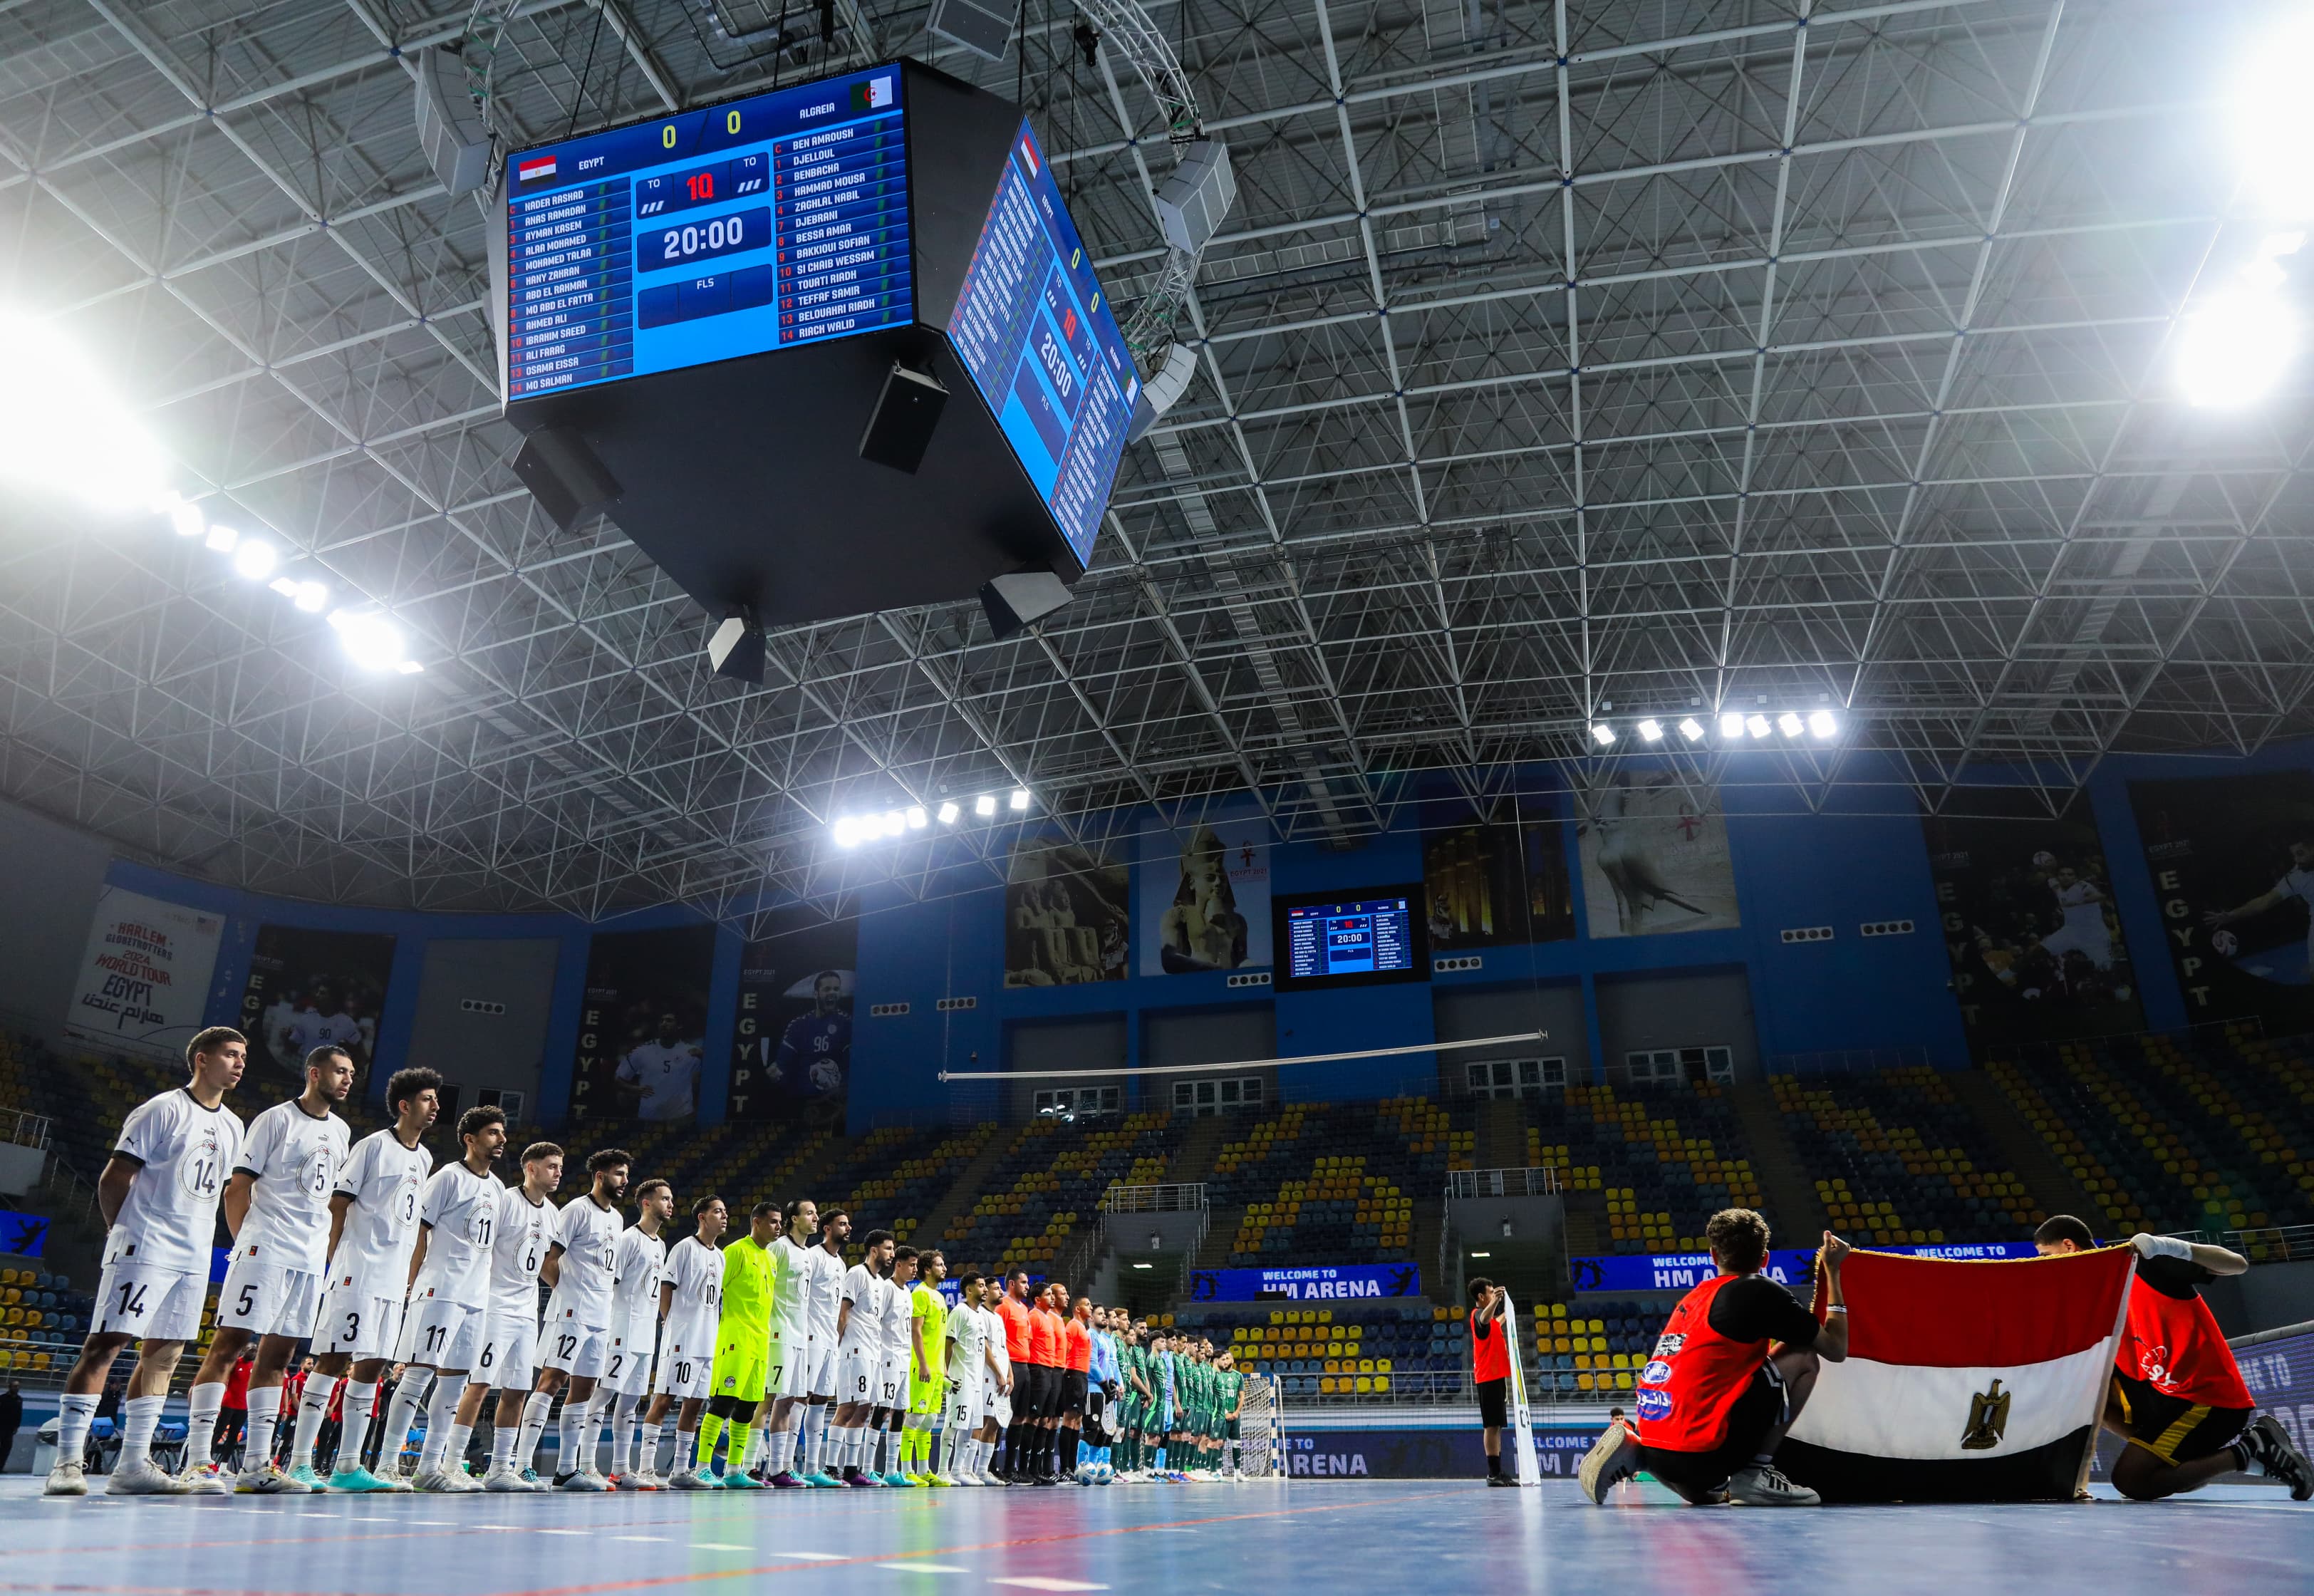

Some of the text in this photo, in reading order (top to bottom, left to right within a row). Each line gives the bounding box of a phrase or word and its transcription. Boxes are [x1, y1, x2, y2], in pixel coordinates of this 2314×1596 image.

[799, 102, 835, 119] ALGREIA
[727, 110, 741, 135] 0
[663, 125, 676, 149] 0
[793, 138, 809, 150] BEN
[812, 128, 853, 145] AMROUSH
[578, 156, 604, 170] EGYPT
[743, 157, 757, 167] TO
[794, 149, 834, 165] DJELLOUL
[648, 179, 660, 189] TO
[777, 163, 839, 184] 2 BENBACHA
[777, 173, 865, 200] 3 HAMMAD MOUSA
[525, 198, 550, 211] NADER
[552, 190, 583, 205] RASHAD
[795, 196, 832, 212] ZAGHLAL
[835, 190, 859, 203] NABIL
[525, 214, 546, 226] ANAS
[548, 204, 586, 221] RAMADAN
[779, 210, 837, 230] 7 DJEBRANI
[526, 227, 553, 241] AYMAN
[555, 221, 581, 234] KASEM
[663, 217, 743, 259] 20:00
[779, 224, 851, 246] 8 BESSA AMAR
[526, 244, 545, 256] ALAA
[547, 235, 586, 251] MOHAMED
[779, 236, 869, 261] 9 BAKKIOUI SOFIAN
[526, 254, 564, 271] MOHAMED
[566, 248, 591, 261] TALAA
[781, 251, 874, 276] 10 SI CHAIB WESSAM
[1072, 247, 1080, 269] 0
[526, 266, 579, 285] HANY ZAHRAN
[697, 277, 715, 290] FLS
[781, 270, 856, 293] 11 TOUATI RIADH
[526, 279, 587, 301] ABD EL RAHMAN
[782, 286, 859, 309] 12 TEFFAF SAMIR
[526, 294, 593, 315] MO ABD EL FATTA
[782, 299, 874, 324] 13 BELOUAHRI RIADH
[1091, 292, 1099, 313] 0
[526, 314, 566, 331] AHMED ALI
[782, 319, 854, 340] 14 RIACH WALID
[526, 326, 586, 346] IBRAHIM SAEED
[526, 345, 565, 361] ALI FARAG
[526, 357, 578, 375] OSAMA EISSA
[1041, 332, 1072, 398] 20:00
[526, 373, 572, 391] MO SALMAN
[118, 922, 167, 947] HARLEM
[1337, 933, 1362, 943] 20:00
[2159, 869, 2210, 1007] EGYPT
[105, 933, 173, 961] GLOBETROTTERS
[123, 950, 150, 965] 2024
[1936, 881, 1981, 1026] EGYPT
[94, 953, 172, 986] WORLD TOUR
[102, 974, 153, 1007] EGYPT
[319, 1027, 331, 1040] 90
[814, 1035, 829, 1052] 96
[732, 993, 757, 1114] EGYPT
[574, 1010, 600, 1120] EGYPT
[663, 1059, 670, 1073] 5
[194, 1159, 214, 1193] 14
[316, 1164, 325, 1191] 5
[406, 1193, 413, 1221] 3
[478, 1218, 491, 1245] 11
[526, 1248, 535, 1271] 6
[605, 1248, 613, 1272] 12
[1915, 1245, 2006, 1258] WELCOME TO
[1263, 1269, 1337, 1280] WELCOME TO
[1654, 1269, 1694, 1287] HM
[651, 1276, 658, 1298] 2
[706, 1284, 715, 1305] 10
[805, 1279, 809, 1297] 7
[835, 1287, 839, 1305] 9
[1304, 1280, 1381, 1299] ARENA
[118, 1282, 147, 1317] 14
[236, 1285, 257, 1316] 5
[343, 1312, 360, 1342] 3
[426, 1325, 447, 1353] 11
[557, 1334, 577, 1360] 12
[977, 1337, 983, 1352] 15
[480, 1342, 493, 1367] 6
[608, 1355, 622, 1378] 2
[675, 1362, 691, 1384] 10
[773, 1366, 782, 1385] 7
[2263, 1353, 2291, 1389] TO
[858, 1375, 866, 1392] 8
[883, 1382, 895, 1399] 13
[1228, 1389, 1235, 1397] 10
[987, 1392, 994, 1407] 4
[956, 1405, 967, 1421] 15
[1295, 1439, 1314, 1449] TO
